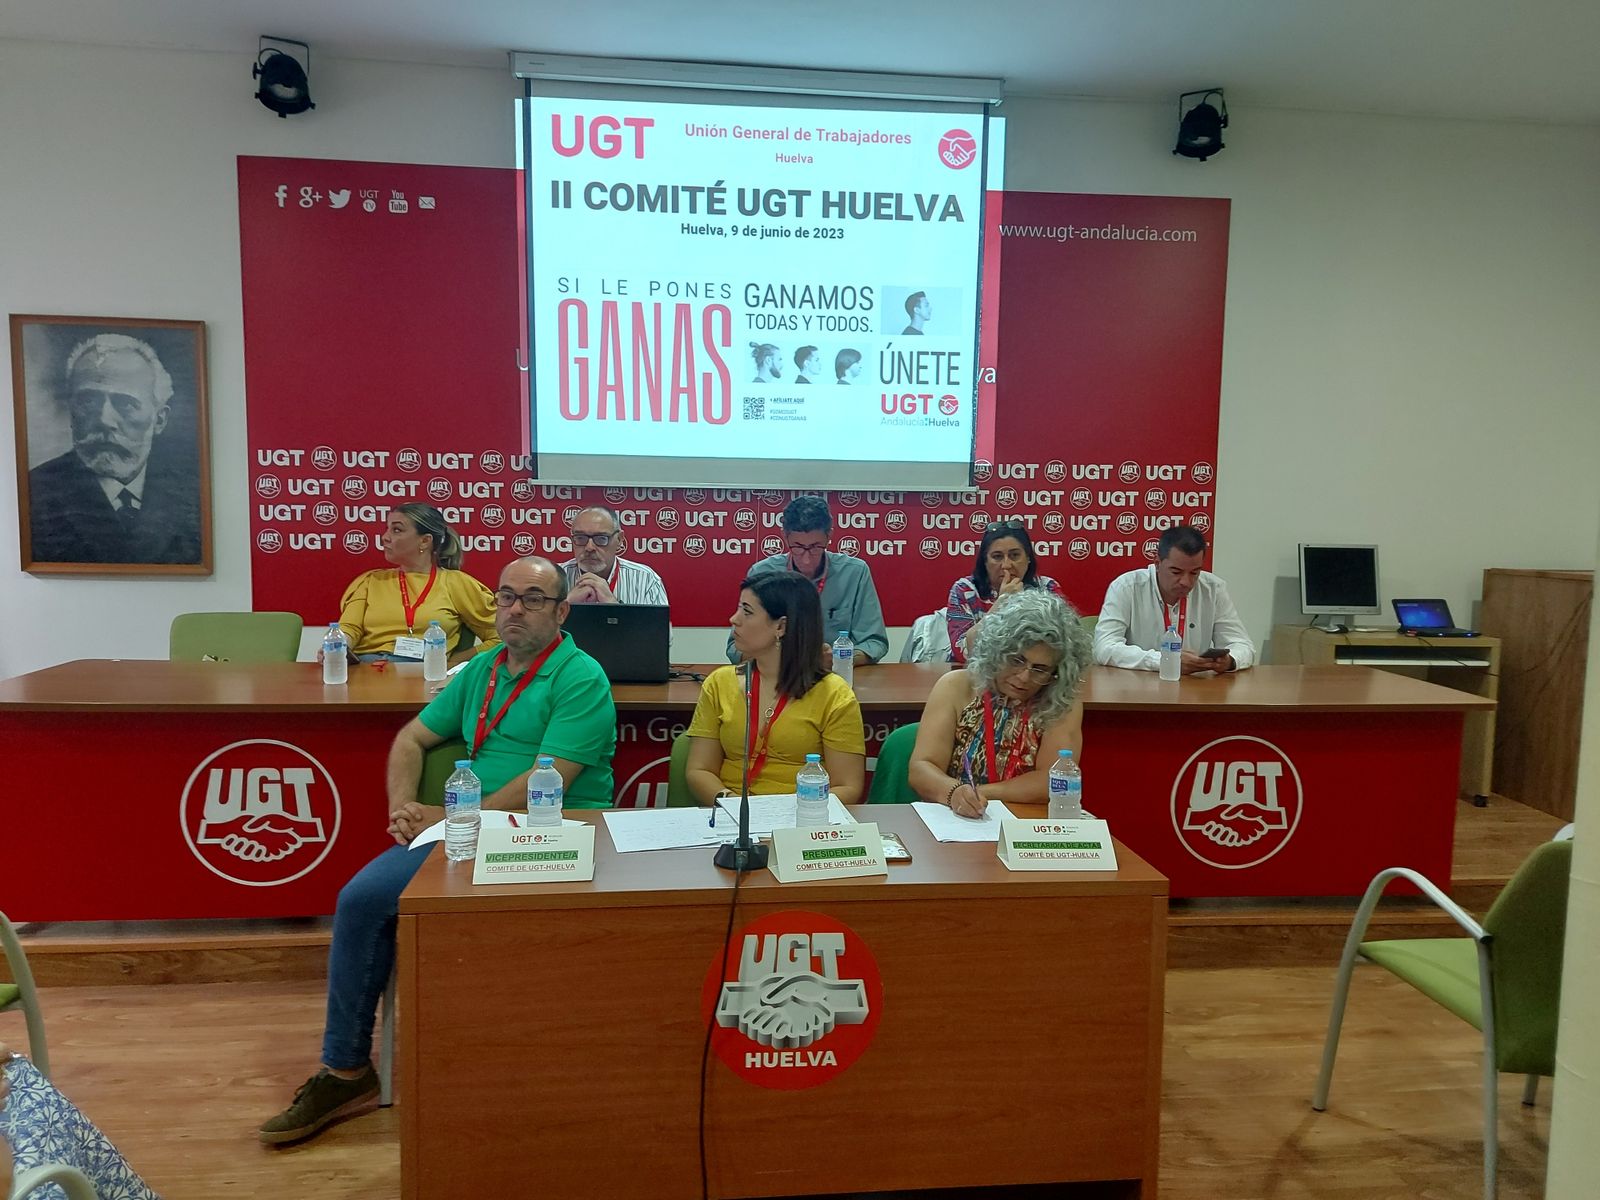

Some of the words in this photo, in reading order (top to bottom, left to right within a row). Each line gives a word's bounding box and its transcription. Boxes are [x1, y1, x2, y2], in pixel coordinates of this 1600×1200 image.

[550, 114, 655, 160] UGT
[684, 122, 728, 139] Unión
[732, 126, 790, 142] General
[794, 128, 812, 142] de
[815, 128, 912, 146] Trabajadores
[775, 152, 814, 164] Huelva
[360, 190, 380, 198] UGT
[392, 190, 404, 200] You
[551, 180, 572, 208] II
[584, 180, 727, 216] COMITÉ
[737, 188, 812, 218] UGT
[822, 191, 964, 222] HUELVA
[390, 201, 406, 211] Tube
[681, 223, 728, 238] Huelva,
[731, 225, 738, 236] 9
[742, 225, 758, 238] de
[760, 225, 791, 240] junio
[794, 226, 810, 239] de
[814, 228, 844, 240] 2023
[999, 224, 1197, 243] www.ugt-andalucia.com
[558, 276, 580, 293] SI
[601, 278, 628, 296] LE
[650, 280, 732, 299] PONES
[744, 282, 874, 312] GANAMOS
[746, 314, 798, 331] TODAS
[802, 315, 814, 332] Y
[816, 316, 874, 333] TODOS.
[557, 298, 732, 425] GANAS
[880, 342, 960, 386] ÚNETE
[881, 393, 934, 415] UGT
[258, 450, 304, 467] UGT
[343, 451, 390, 468] UGT
[428, 453, 473, 470] UGT
[998, 464, 1039, 479] UGT
[1072, 464, 1113, 480] UGT
[1146, 466, 1186, 480] UGT
[288, 479, 334, 496] UGT
[374, 480, 420, 497] UGT
[459, 482, 504, 498] UGT
[542, 486, 586, 500] UGT
[634, 488, 677, 502] UGT
[866, 492, 906, 505] UGT
[950, 491, 990, 506] UGT
[1024, 491, 1064, 506] UGT
[1098, 492, 1138, 506] UGT
[1172, 492, 1212, 507] UGT
[259, 504, 306, 521] UGT
[344, 506, 390, 522] UGT
[512, 508, 556, 525] UGT
[685, 511, 728, 527] UGT
[838, 513, 880, 529] UGT
[923, 514, 964, 530] UGT
[1070, 515, 1111, 530] UGT
[1144, 516, 1184, 530] UGT
[290, 534, 336, 550] UGT
[460, 536, 504, 552] UGT
[634, 538, 676, 554] UGT
[712, 538, 754, 554] UGT
[866, 540, 907, 556] UGT
[1096, 541, 1136, 556] UGT
[1190, 761, 1282, 811] UGT
[204, 768, 315, 822] UGT
[810, 832, 830, 840] UGT
[486, 851, 578, 862] VICEPRESIDENTE/A
[802, 846, 867, 860] PRESIDENTE/A
[528, 863, 576, 871] UGT-HUELVA
[834, 858, 878, 868] UGT-HUELVA
[738, 933, 846, 983] UGT
[745, 1051, 838, 1068] HUELVA
